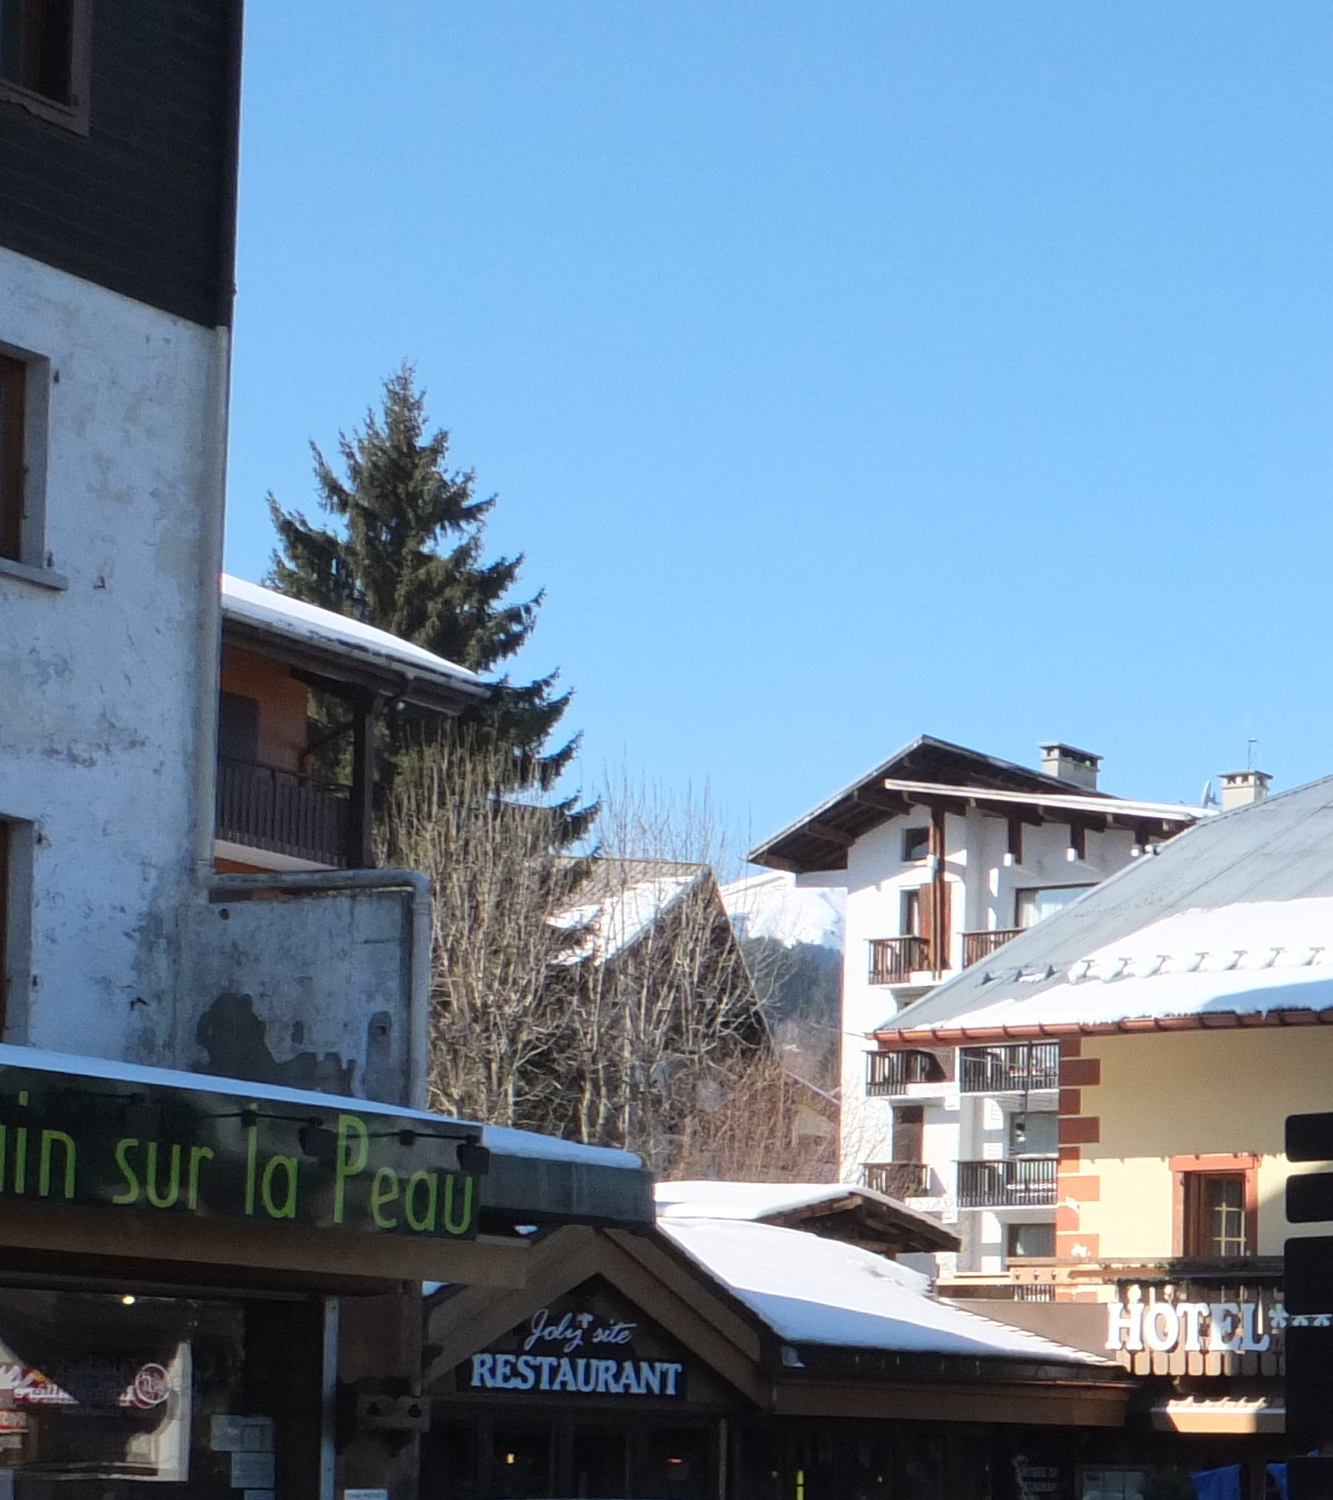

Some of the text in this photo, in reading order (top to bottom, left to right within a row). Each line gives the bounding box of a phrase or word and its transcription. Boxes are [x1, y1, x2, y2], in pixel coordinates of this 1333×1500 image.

[0, 1090, 473, 1235] in sur la Peau
[524, 1309, 637, 1353] Joly site
[471, 1353, 682, 1395] RESTAURANT
